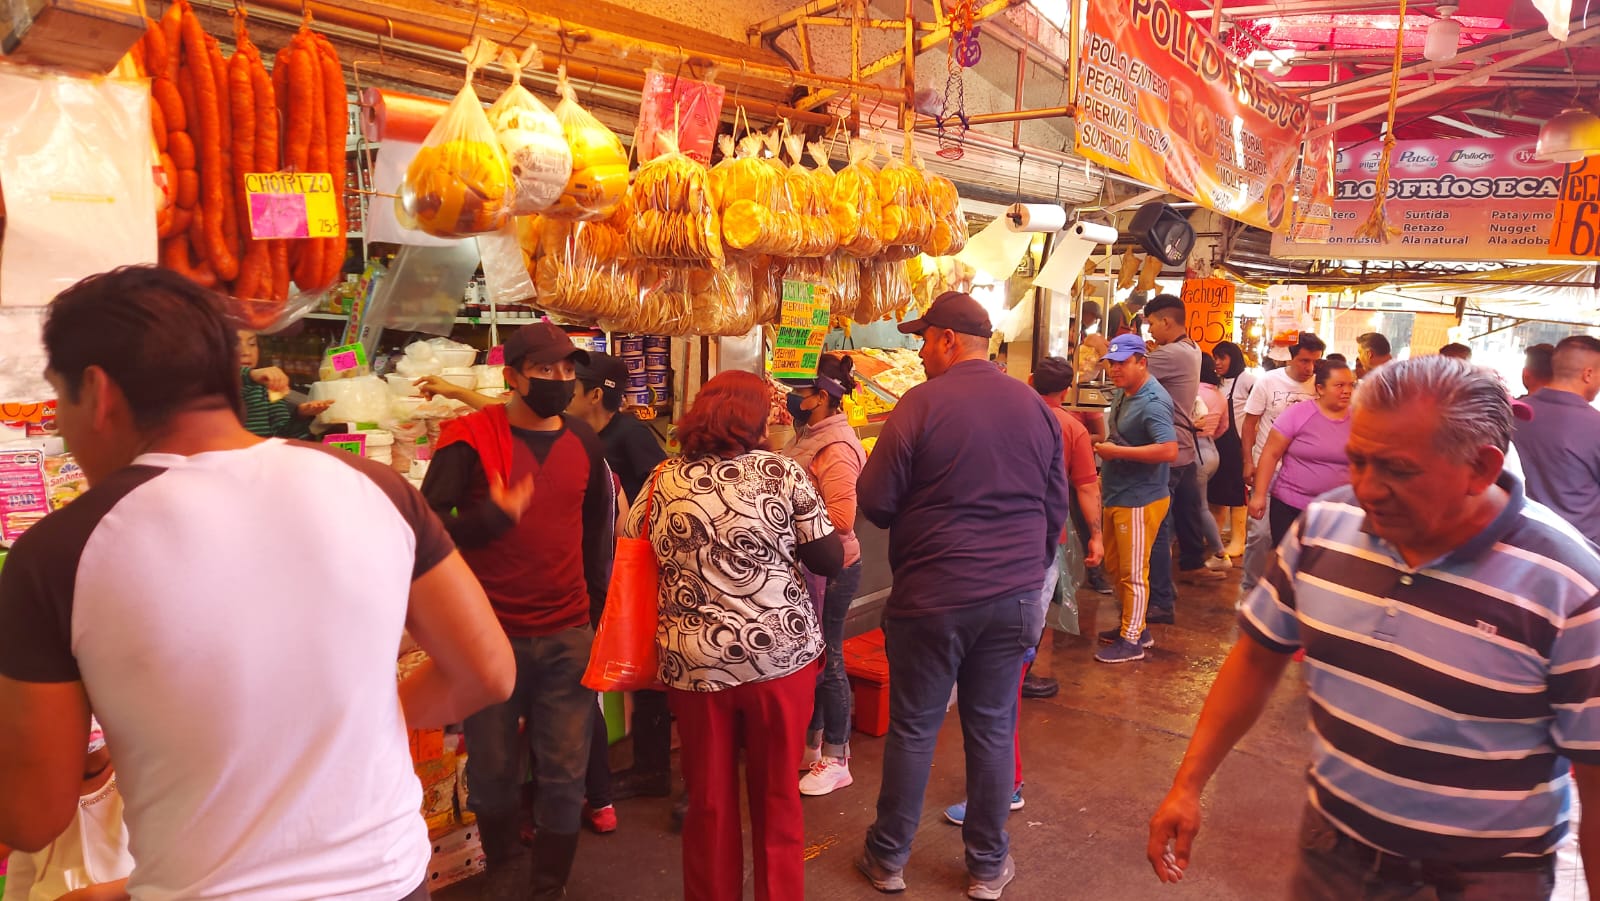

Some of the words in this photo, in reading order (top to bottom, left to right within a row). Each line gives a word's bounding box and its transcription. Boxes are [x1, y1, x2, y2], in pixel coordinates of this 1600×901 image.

[1132, 0, 1222, 81] POLLO
[1225, 57, 1306, 131] FRESCO
[1128, 62, 1168, 100] ENTERO
[1084, 96, 1128, 133] PIERNA
[1131, 117, 1138, 135] Y
[1082, 124, 1129, 161] SURTIDA
[1519, 150, 1537, 162] Tys
[1359, 160, 1380, 169] pilgri
[1560, 157, 1600, 202] Pec
[1400, 175, 1493, 199] FRÍOS
[1493, 177, 1559, 198] ECA
[1405, 210, 1449, 219] Surtida
[1491, 211, 1519, 219] Pata
[1521, 213, 1530, 221] y
[1403, 223, 1445, 232] Retazo
[1489, 223, 1537, 235] Nugget
[1401, 235, 1421, 244] Ala
[1424, 235, 1468, 244] natural
[1487, 236, 1509, 245] Ala
[1511, 236, 1551, 245] adoba
[1181, 280, 1230, 308] Pechuga
[50, 477, 65, 487] San
[66, 471, 86, 482] Anto
